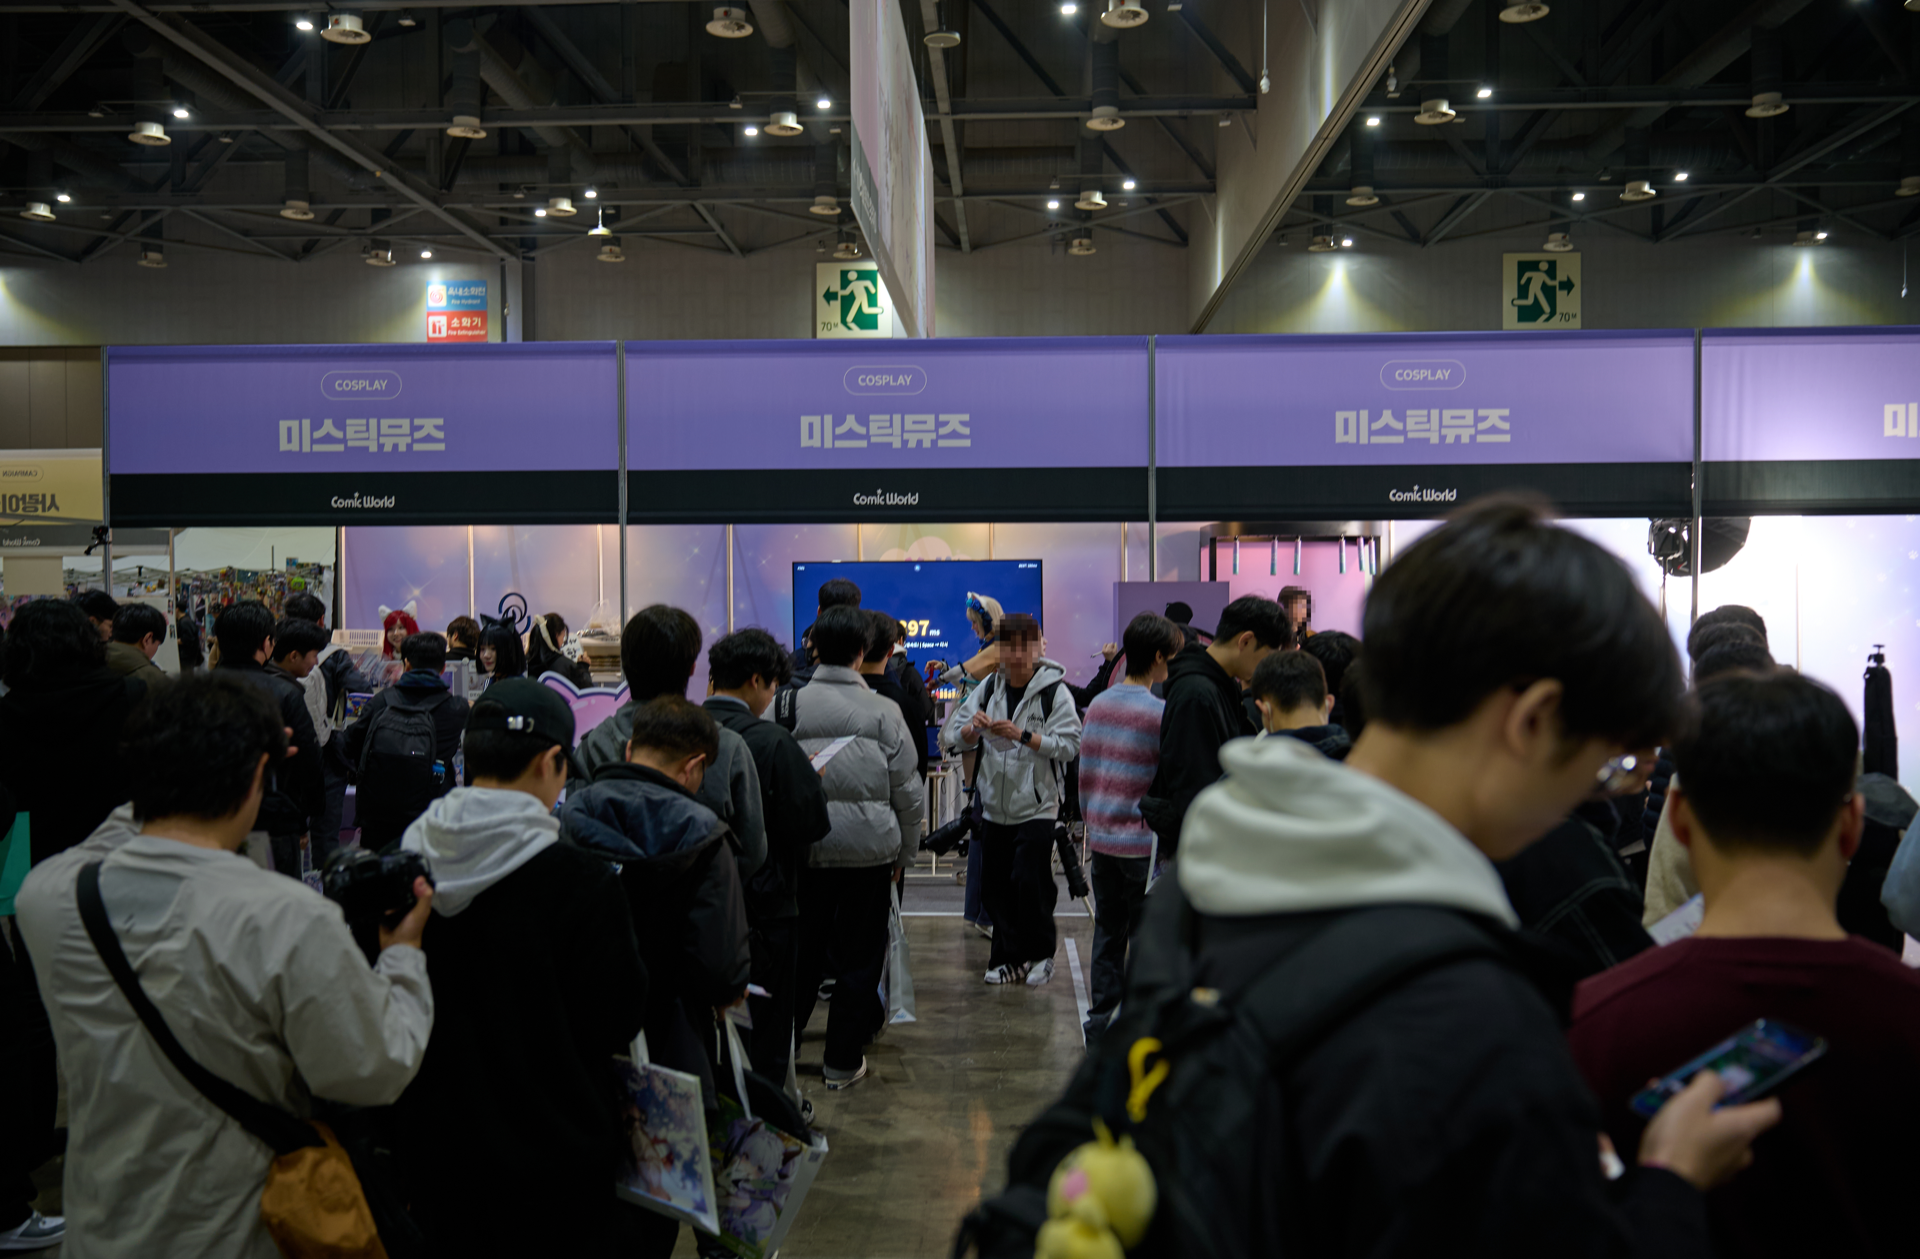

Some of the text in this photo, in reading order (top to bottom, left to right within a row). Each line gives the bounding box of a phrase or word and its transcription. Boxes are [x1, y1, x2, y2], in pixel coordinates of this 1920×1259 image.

[451, 317, 482, 328] 소화기
[858, 374, 913, 387] COSPLAY
[1396, 369, 1451, 381] COSPLAY
[334, 380, 388, 391] COSPLAY
[1335, 408, 1511, 444] 미스틱뮤즈
[1884, 402, 1920, 438] 미
[279, 418, 446, 453] 미스틱뮤즈
[800, 413, 972, 449] 미스틱뮤즈
[331, 492, 395, 508] Comic World
[853, 488, 919, 505] Comic World
[1389, 484, 1457, 501] Comic World
